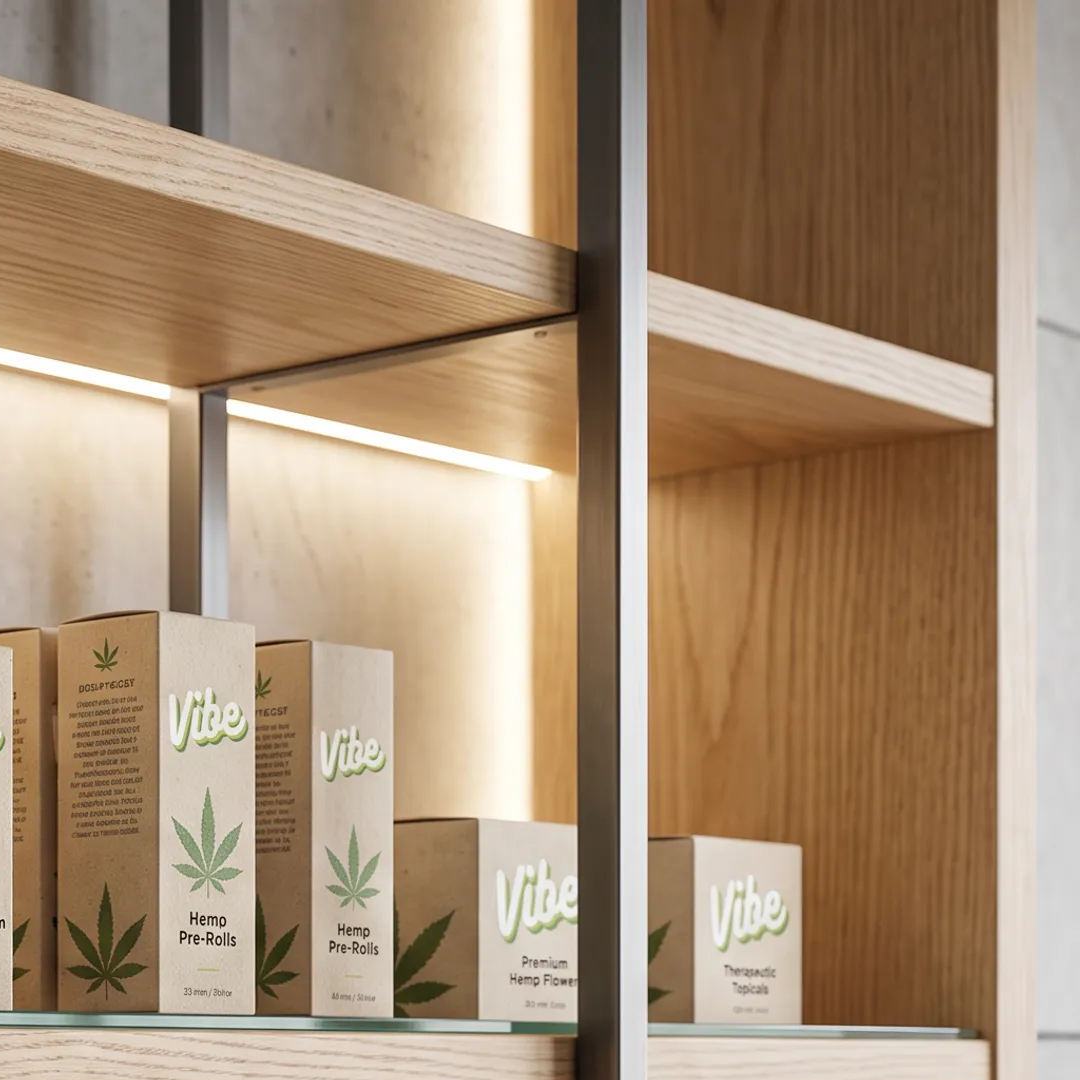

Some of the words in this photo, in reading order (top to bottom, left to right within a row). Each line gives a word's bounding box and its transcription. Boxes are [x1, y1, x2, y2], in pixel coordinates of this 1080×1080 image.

[169, 687, 249, 752] Vibe
[320, 725, 386, 782] Vibe
[496, 858, 578, 944] Vibe
[189, 911, 227, 929] Hemp
[710, 874, 789, 953] Vibe
[179, 930, 237, 948] Pre-Rolls
[337, 922, 371, 940] Hemp
[328, 940, 379, 956] Pre-Rolls
[521, 955, 568, 969] Premium
[509, 973, 541, 988] Hemp
